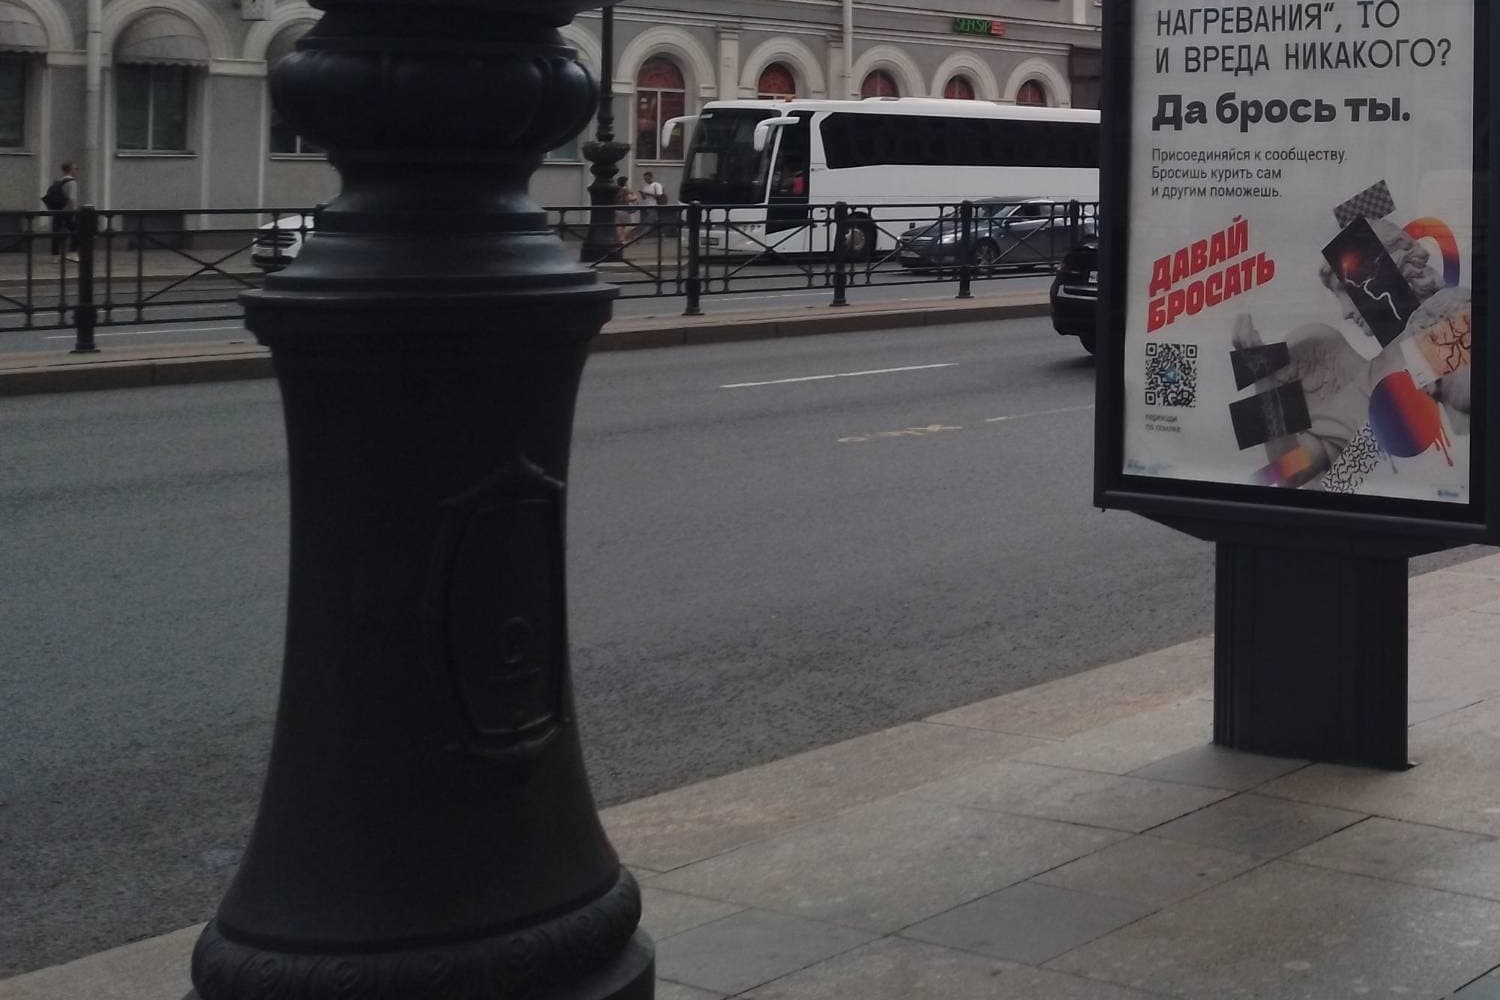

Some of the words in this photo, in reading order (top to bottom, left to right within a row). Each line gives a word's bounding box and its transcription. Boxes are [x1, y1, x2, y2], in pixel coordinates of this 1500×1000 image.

[1357, 0, 1401, 30] ТО
[1156, 47, 1169, 74] И
[1184, 44, 1270, 77] ВРЕДА
[1285, 38, 1452, 71] НИКАКОГО?
[1152, 95, 1208, 131] Да
[1216, 92, 1337, 132] брось
[1344, 97, 1411, 122] ты.
[1152, 147, 1250, 165] Присоединяйся
[1255, 150, 1262, 161] к
[1264, 147, 1348, 165] сообществу.
[1152, 166, 1207, 181] Бросишь
[1211, 168, 1253, 182] курить
[1256, 168, 1282, 180] сам
[1152, 186, 1159, 197] и
[1162, 186, 1206, 200] другим
[1210, 186, 1283, 199] поможешь.
[1149, 215, 1249, 298] ДАВАЙ
[1147, 252, 1276, 333] БРОСАТЬ
